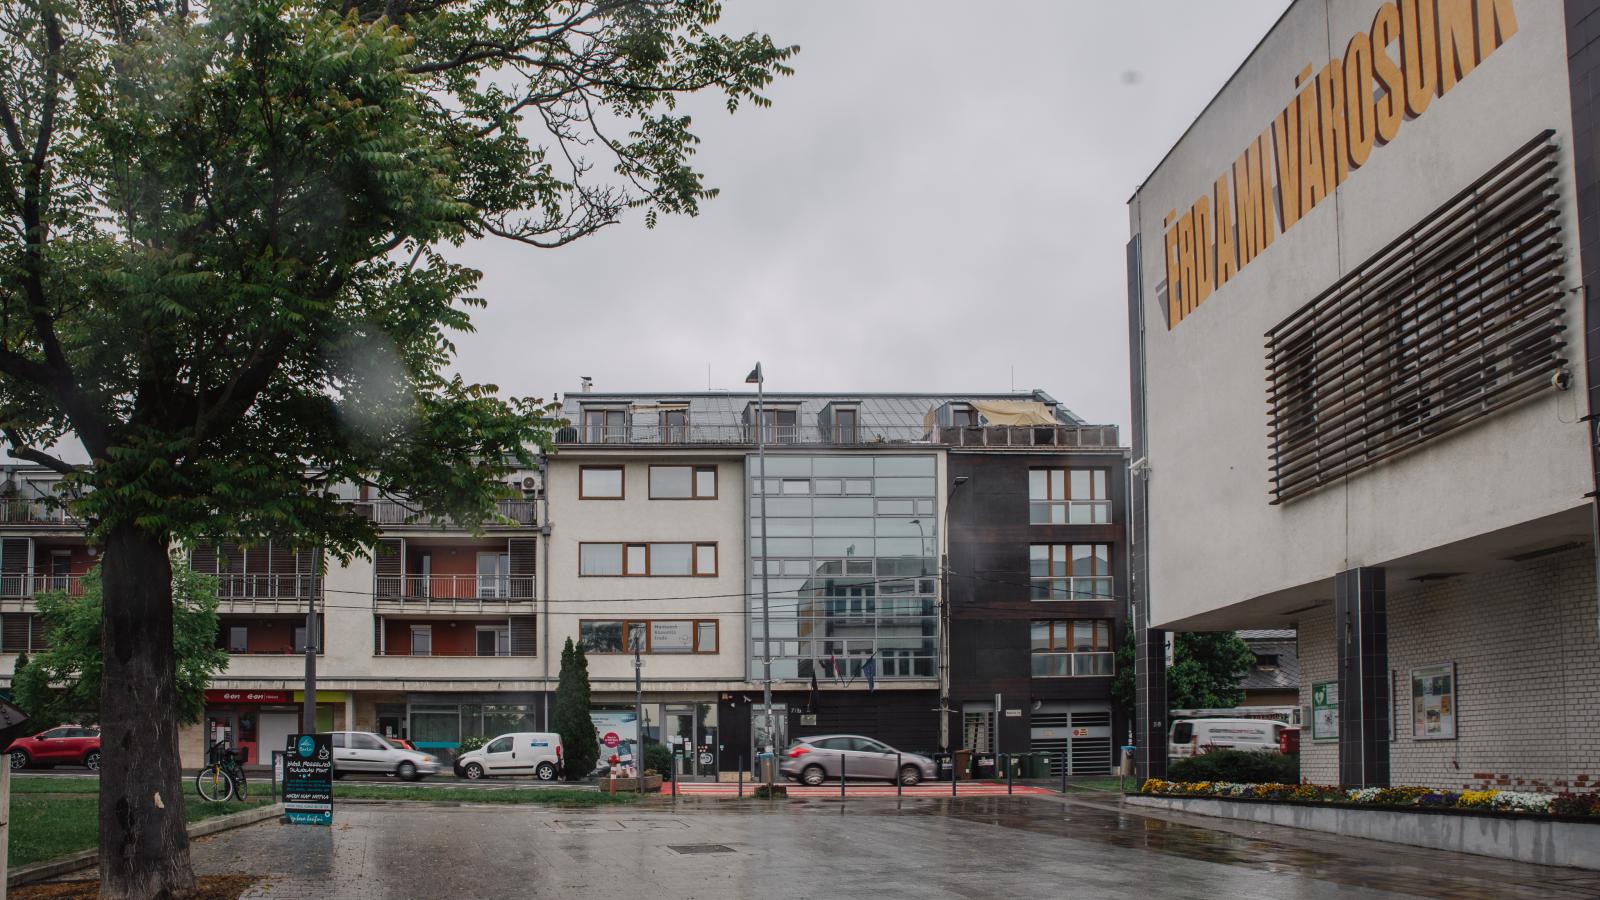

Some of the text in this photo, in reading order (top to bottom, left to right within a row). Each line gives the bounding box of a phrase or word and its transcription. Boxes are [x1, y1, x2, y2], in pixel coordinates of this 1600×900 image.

[1164, 194, 1214, 332] ÉRD
[1213, 171, 1237, 291] A
[1231, 127, 1275, 272] MI
